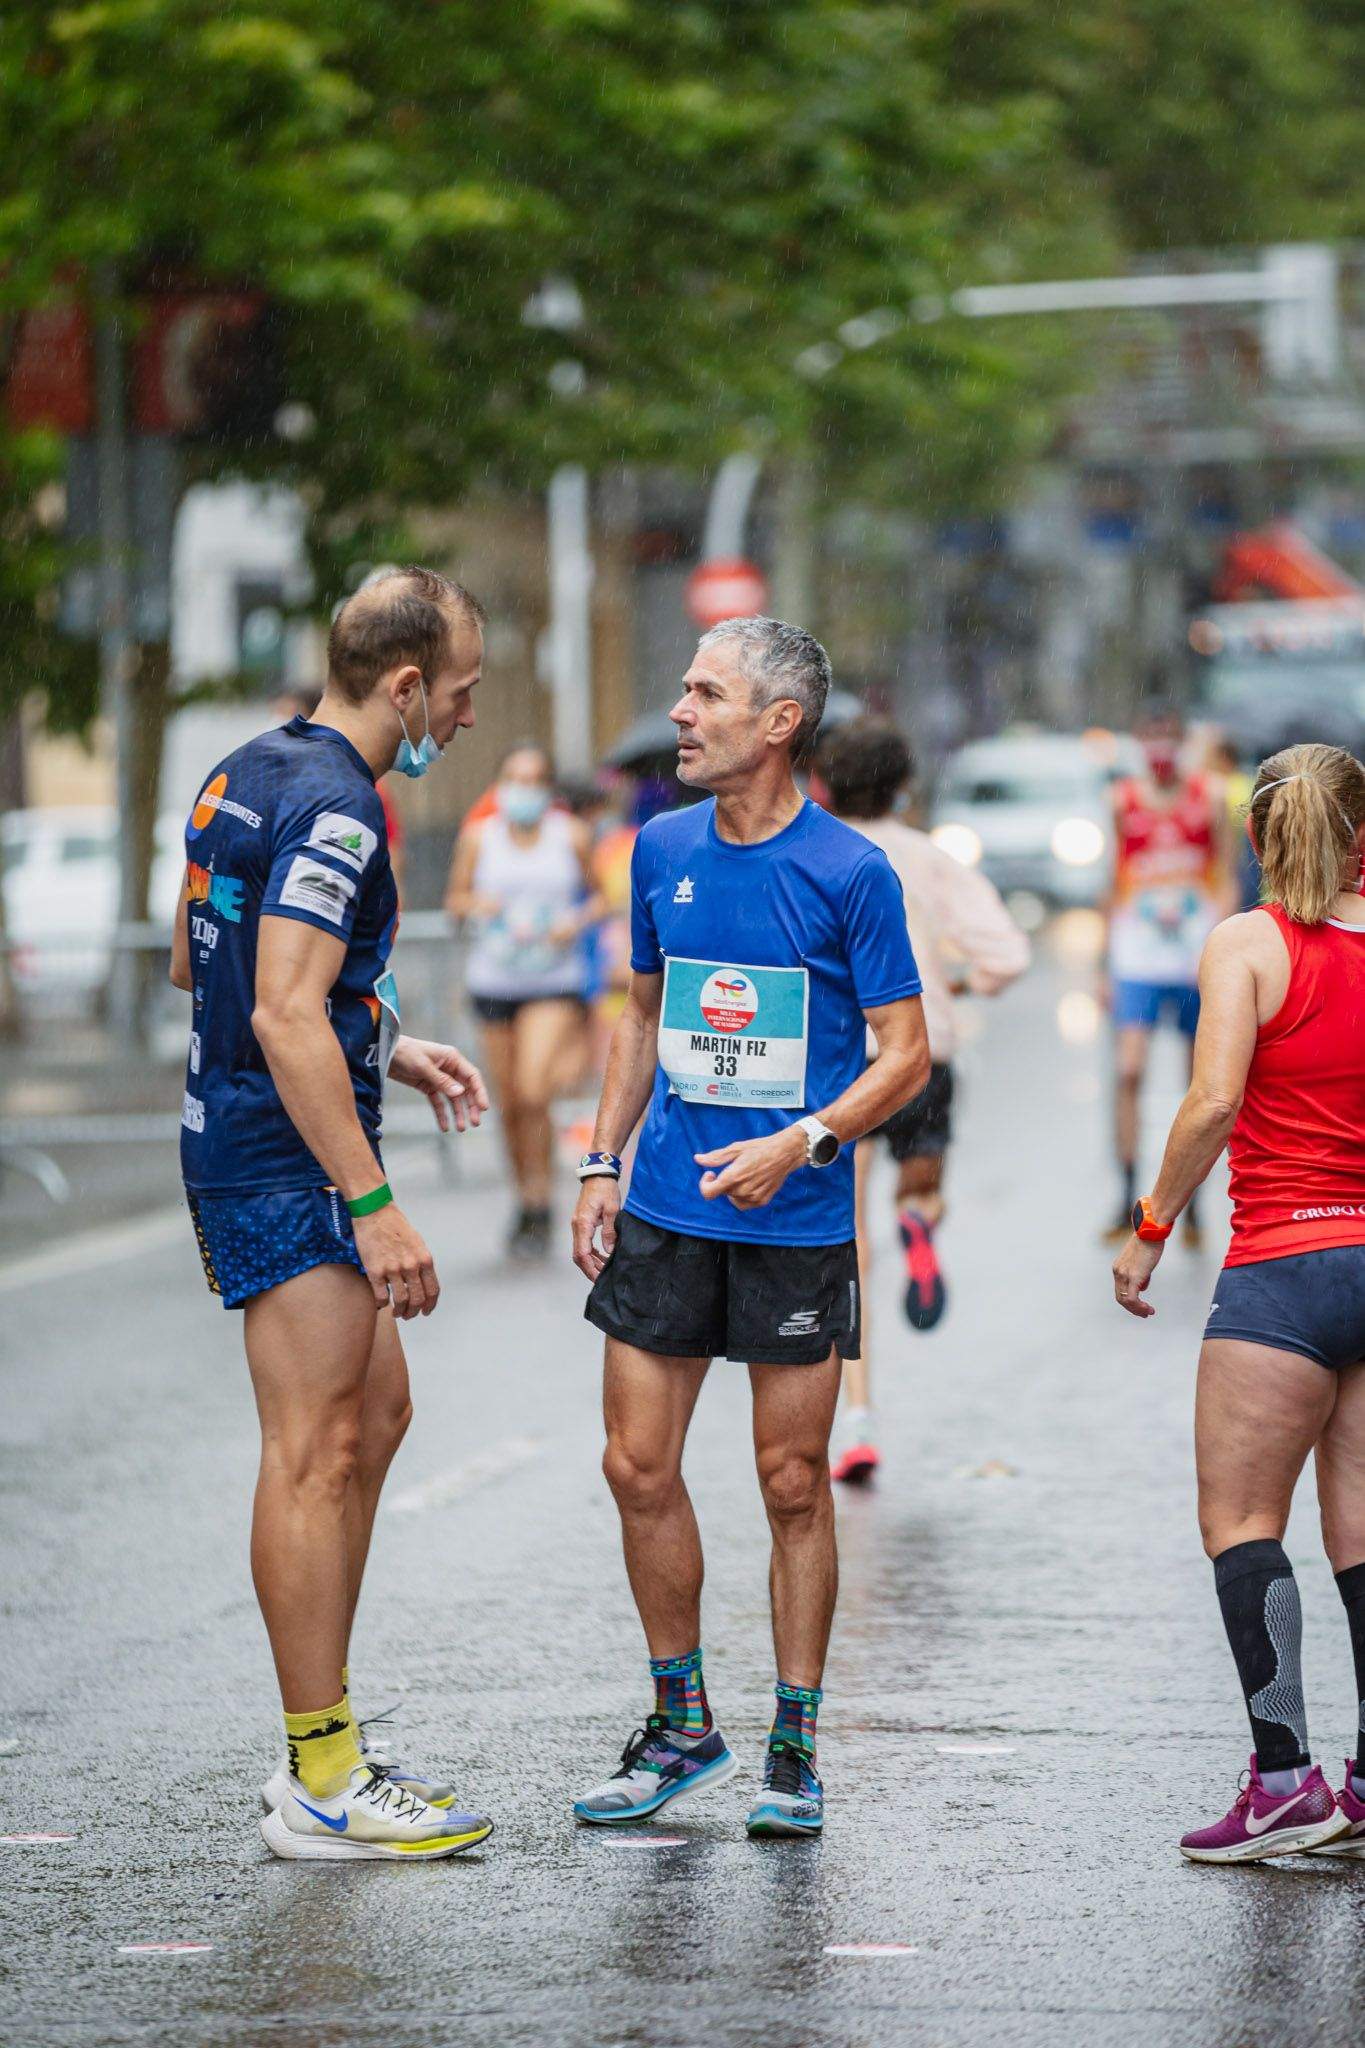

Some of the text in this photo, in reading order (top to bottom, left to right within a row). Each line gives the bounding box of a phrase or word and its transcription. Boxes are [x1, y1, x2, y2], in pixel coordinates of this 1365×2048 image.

[690, 1034, 767, 1057] MARTÍN FIZ
[714, 1055, 737, 1077] 33
[1292, 1206, 1355, 1220] GRUPO
